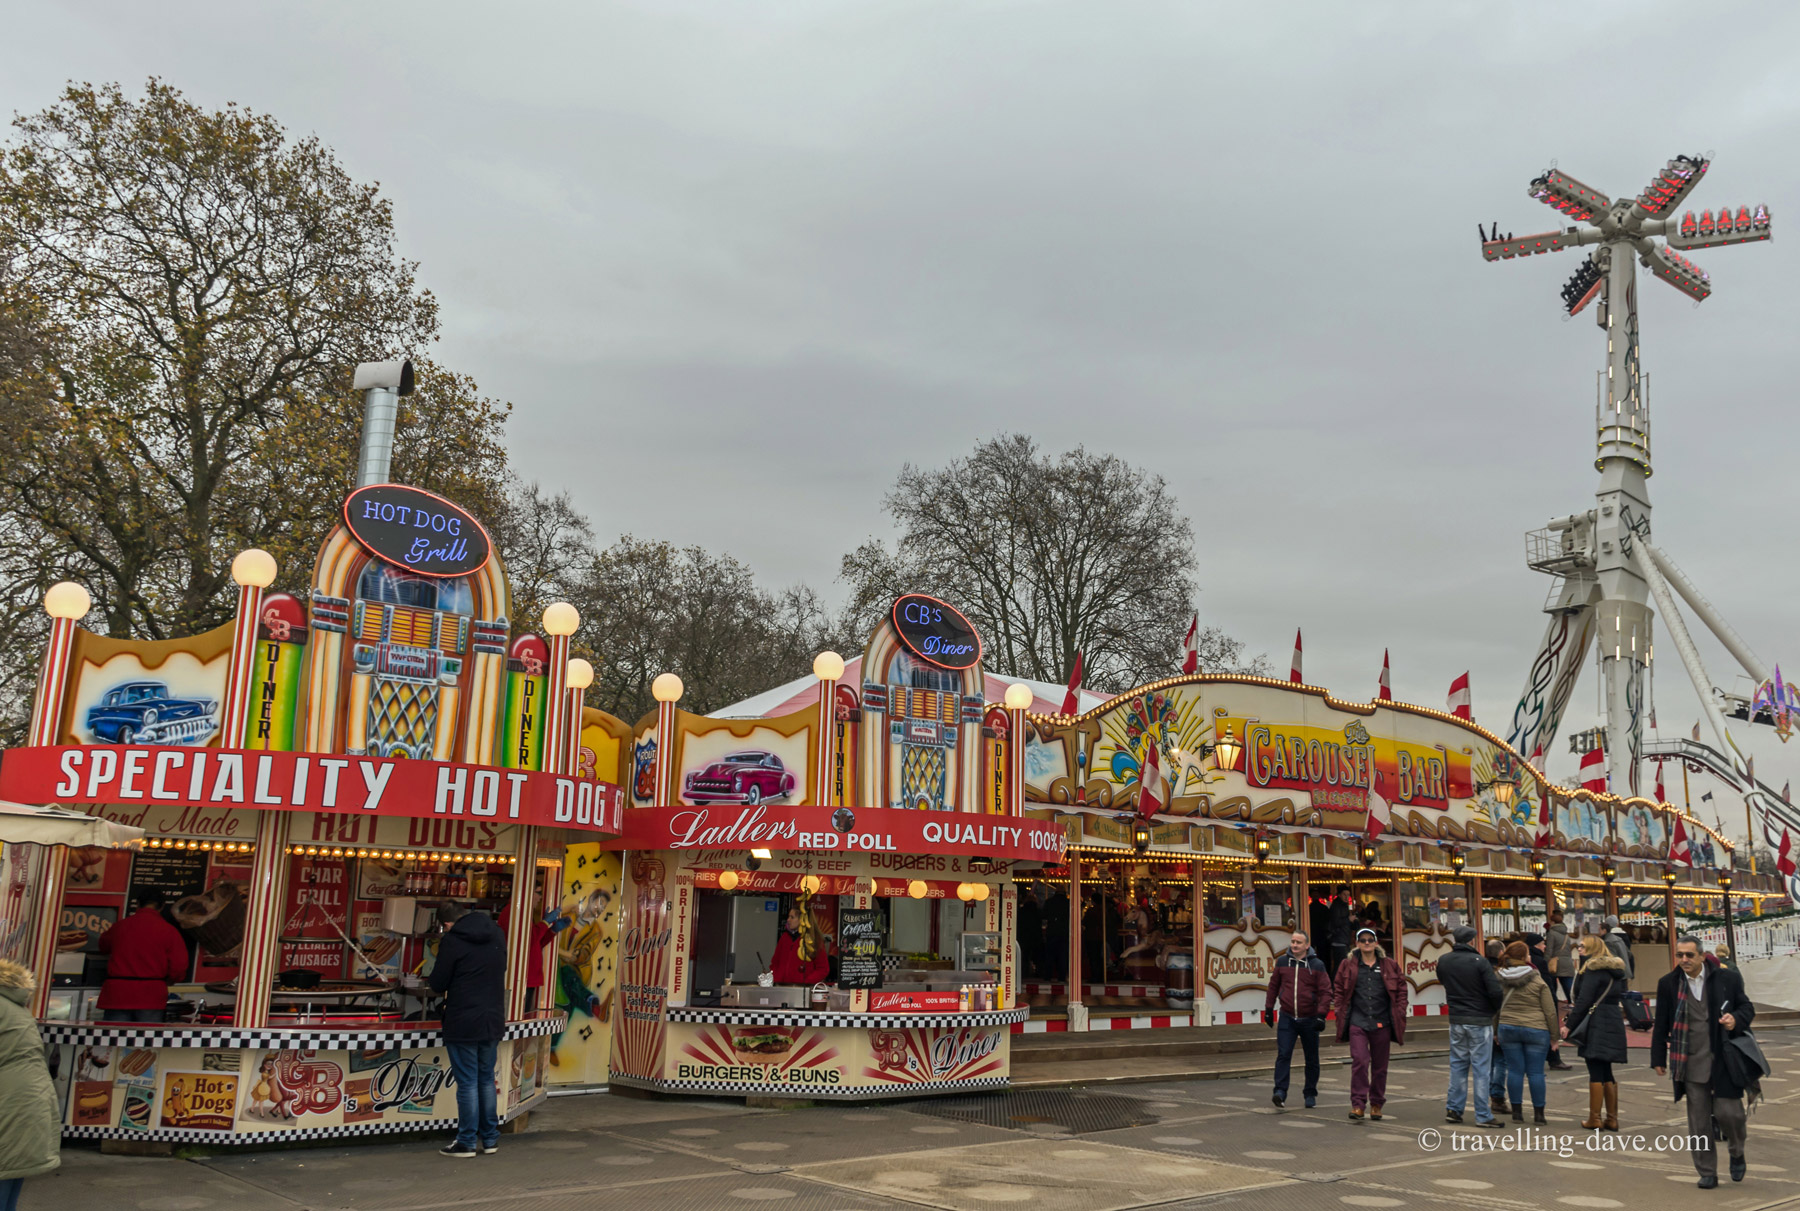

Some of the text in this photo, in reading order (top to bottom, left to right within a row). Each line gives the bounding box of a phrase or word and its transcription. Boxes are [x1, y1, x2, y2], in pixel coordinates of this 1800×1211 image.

[363, 500, 461, 536] HOT DOG
[404, 537, 468, 563] Grill
[904, 603, 942, 625] CB's
[922, 635, 974, 655] Diner
[258, 643, 281, 739] DINER
[518, 680, 535, 765] DINER
[640, 750, 656, 761] ROUT
[836, 723, 845, 796] DINER
[1251, 727, 1445, 801] CAROUSEL BAR
[56, 749, 395, 810] SPECIALITY
[433, 766, 529, 818] HOT
[555, 777, 607, 827] DOG
[995, 743, 1003, 811] DINER
[158, 806, 240, 836] Made
[311, 811, 498, 850] HOT DOGS
[669, 805, 897, 851] Ladlers RED POLL
[922, 821, 1023, 848] QUALITY
[1028, 829, 1058, 852] 100%
[708, 862, 723, 870] RED
[780, 858, 852, 871] 100% BEEF
[870, 852, 946, 872] BURGERS
[951, 858, 962, 873] &
[301, 866, 343, 884] CHAR
[737, 870, 781, 888] Hand
[296, 889, 342, 906] GRILL
[884, 887, 905, 896] BEEF
[362, 917, 379, 928] HOT
[1005, 902, 1013, 962] BRITISH
[673, 888, 688, 994] BRITISH BEEF
[284, 954, 340, 967] SAUSAGES
[1210, 957, 1265, 979] CAROUSEL
[643, 984, 668, 998] Seating
[643, 997, 659, 1008] Food
[931, 1030, 1002, 1075] Diner
[370, 1053, 456, 1112] Din
[678, 1064, 840, 1084] BURGERS & BUNS
[194, 1078, 224, 1094] Hot
[190, 1094, 234, 1114] Dogs
